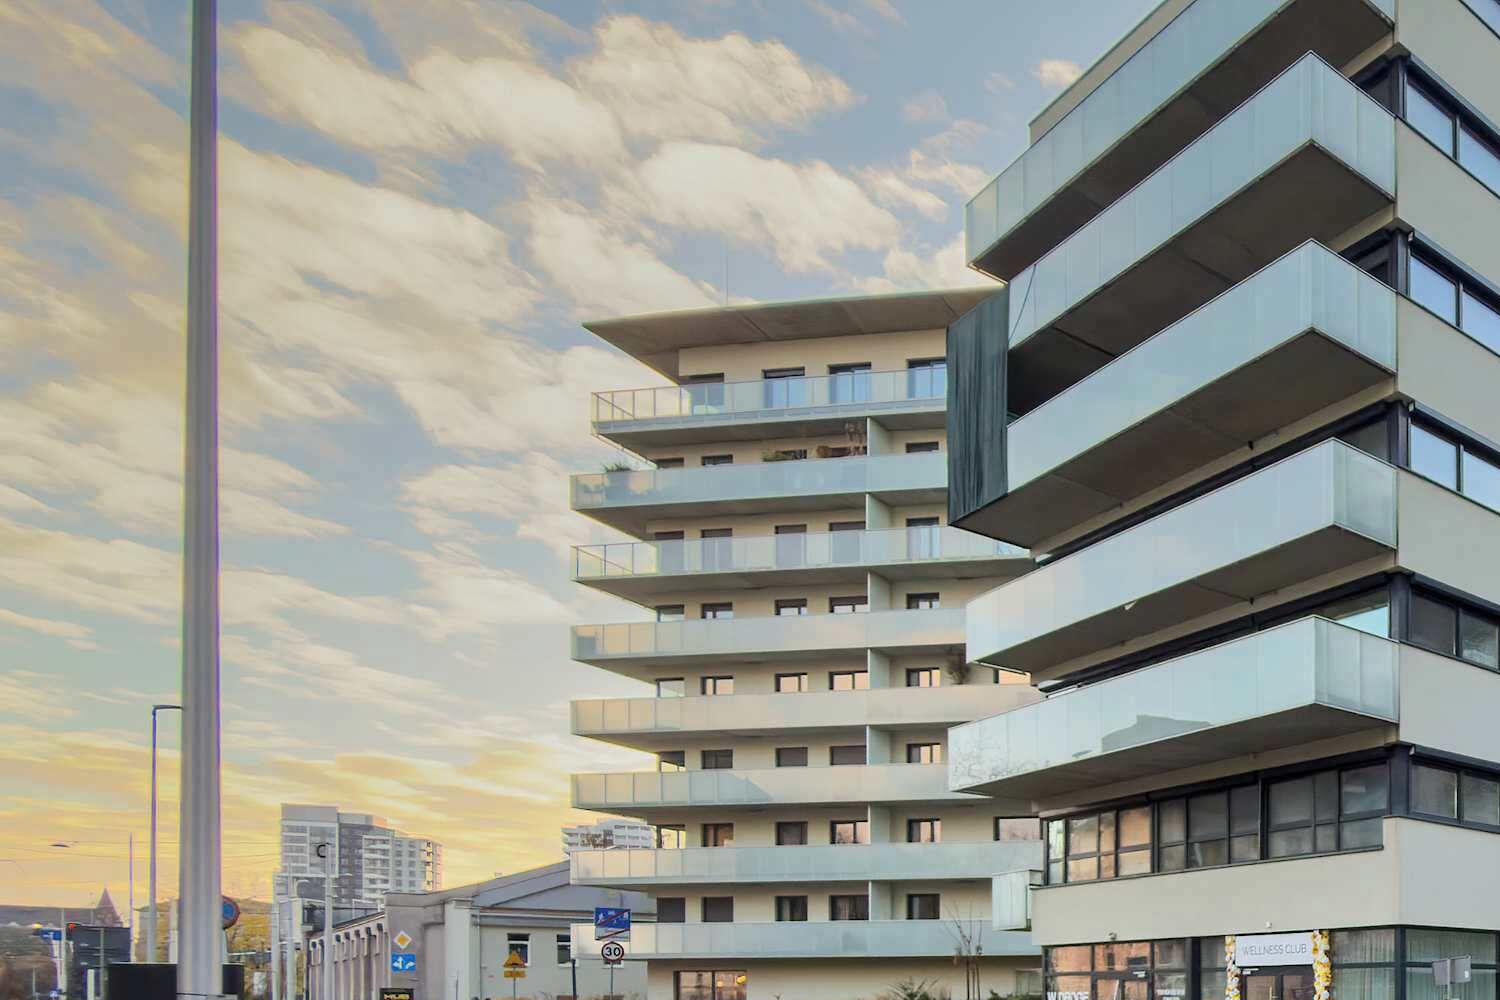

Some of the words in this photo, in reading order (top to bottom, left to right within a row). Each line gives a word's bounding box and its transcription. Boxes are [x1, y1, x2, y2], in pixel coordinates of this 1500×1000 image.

[605, 947, 621, 957] 30
[1241, 945, 1284, 955] WELLNESS
[1285, 944, 1307, 953] CLUB
